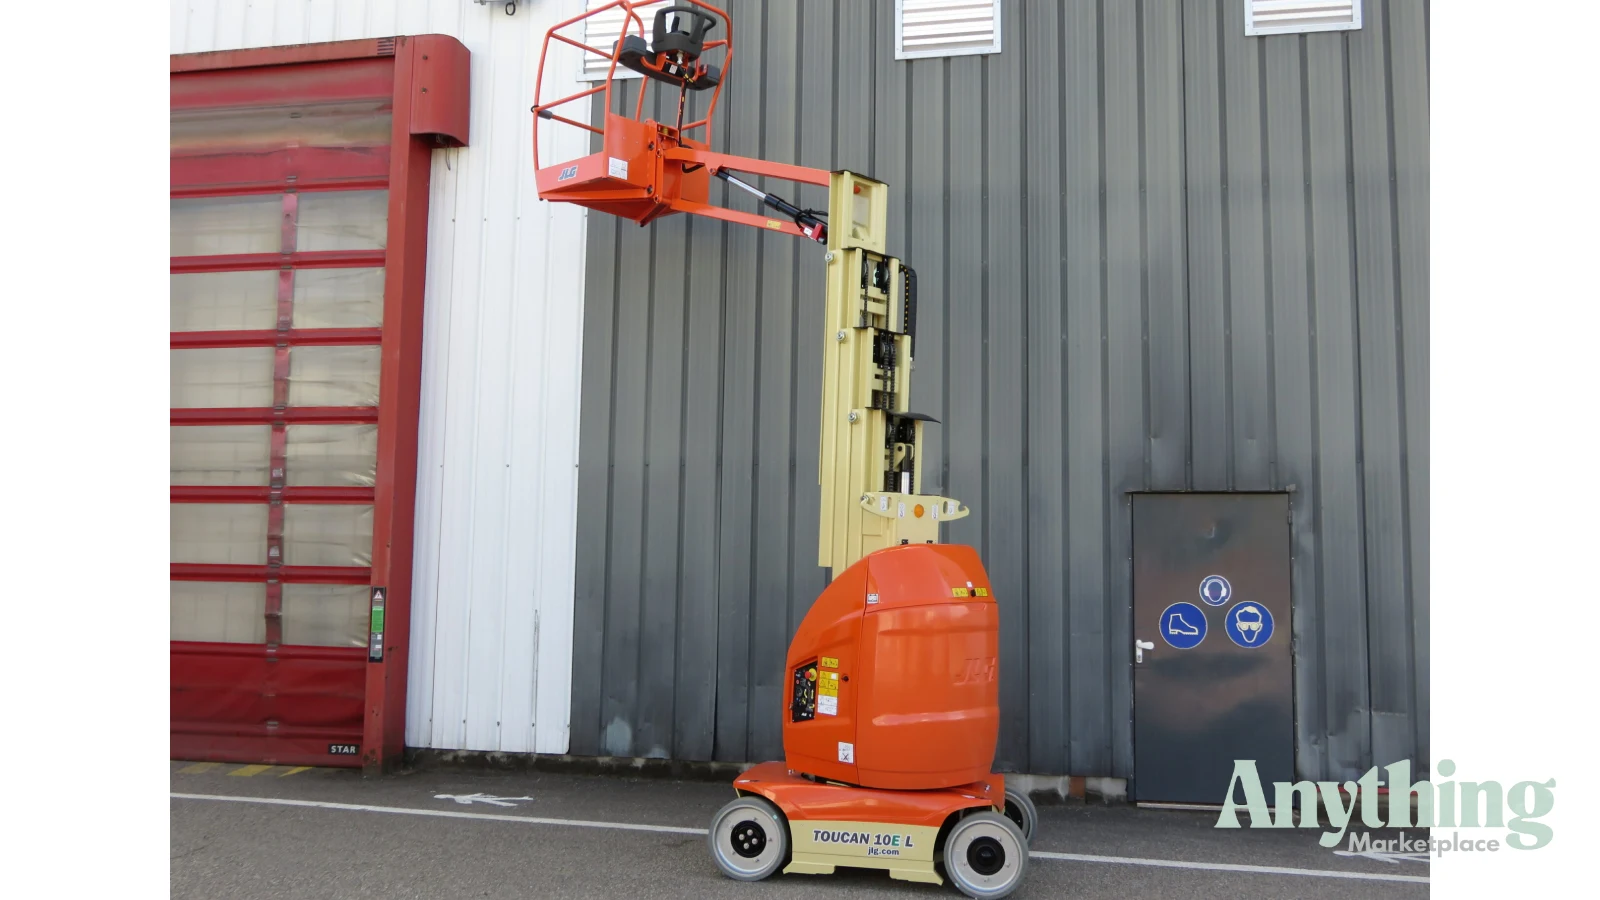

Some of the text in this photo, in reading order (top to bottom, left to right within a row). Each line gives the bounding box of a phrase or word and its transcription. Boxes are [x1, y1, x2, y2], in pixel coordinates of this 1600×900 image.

[558, 165, 578, 181] JLG
[330, 745, 356, 754] STAR
[813, 829, 914, 848] TOUCAN 10E L
[867, 846, 900, 856] jlg.com
